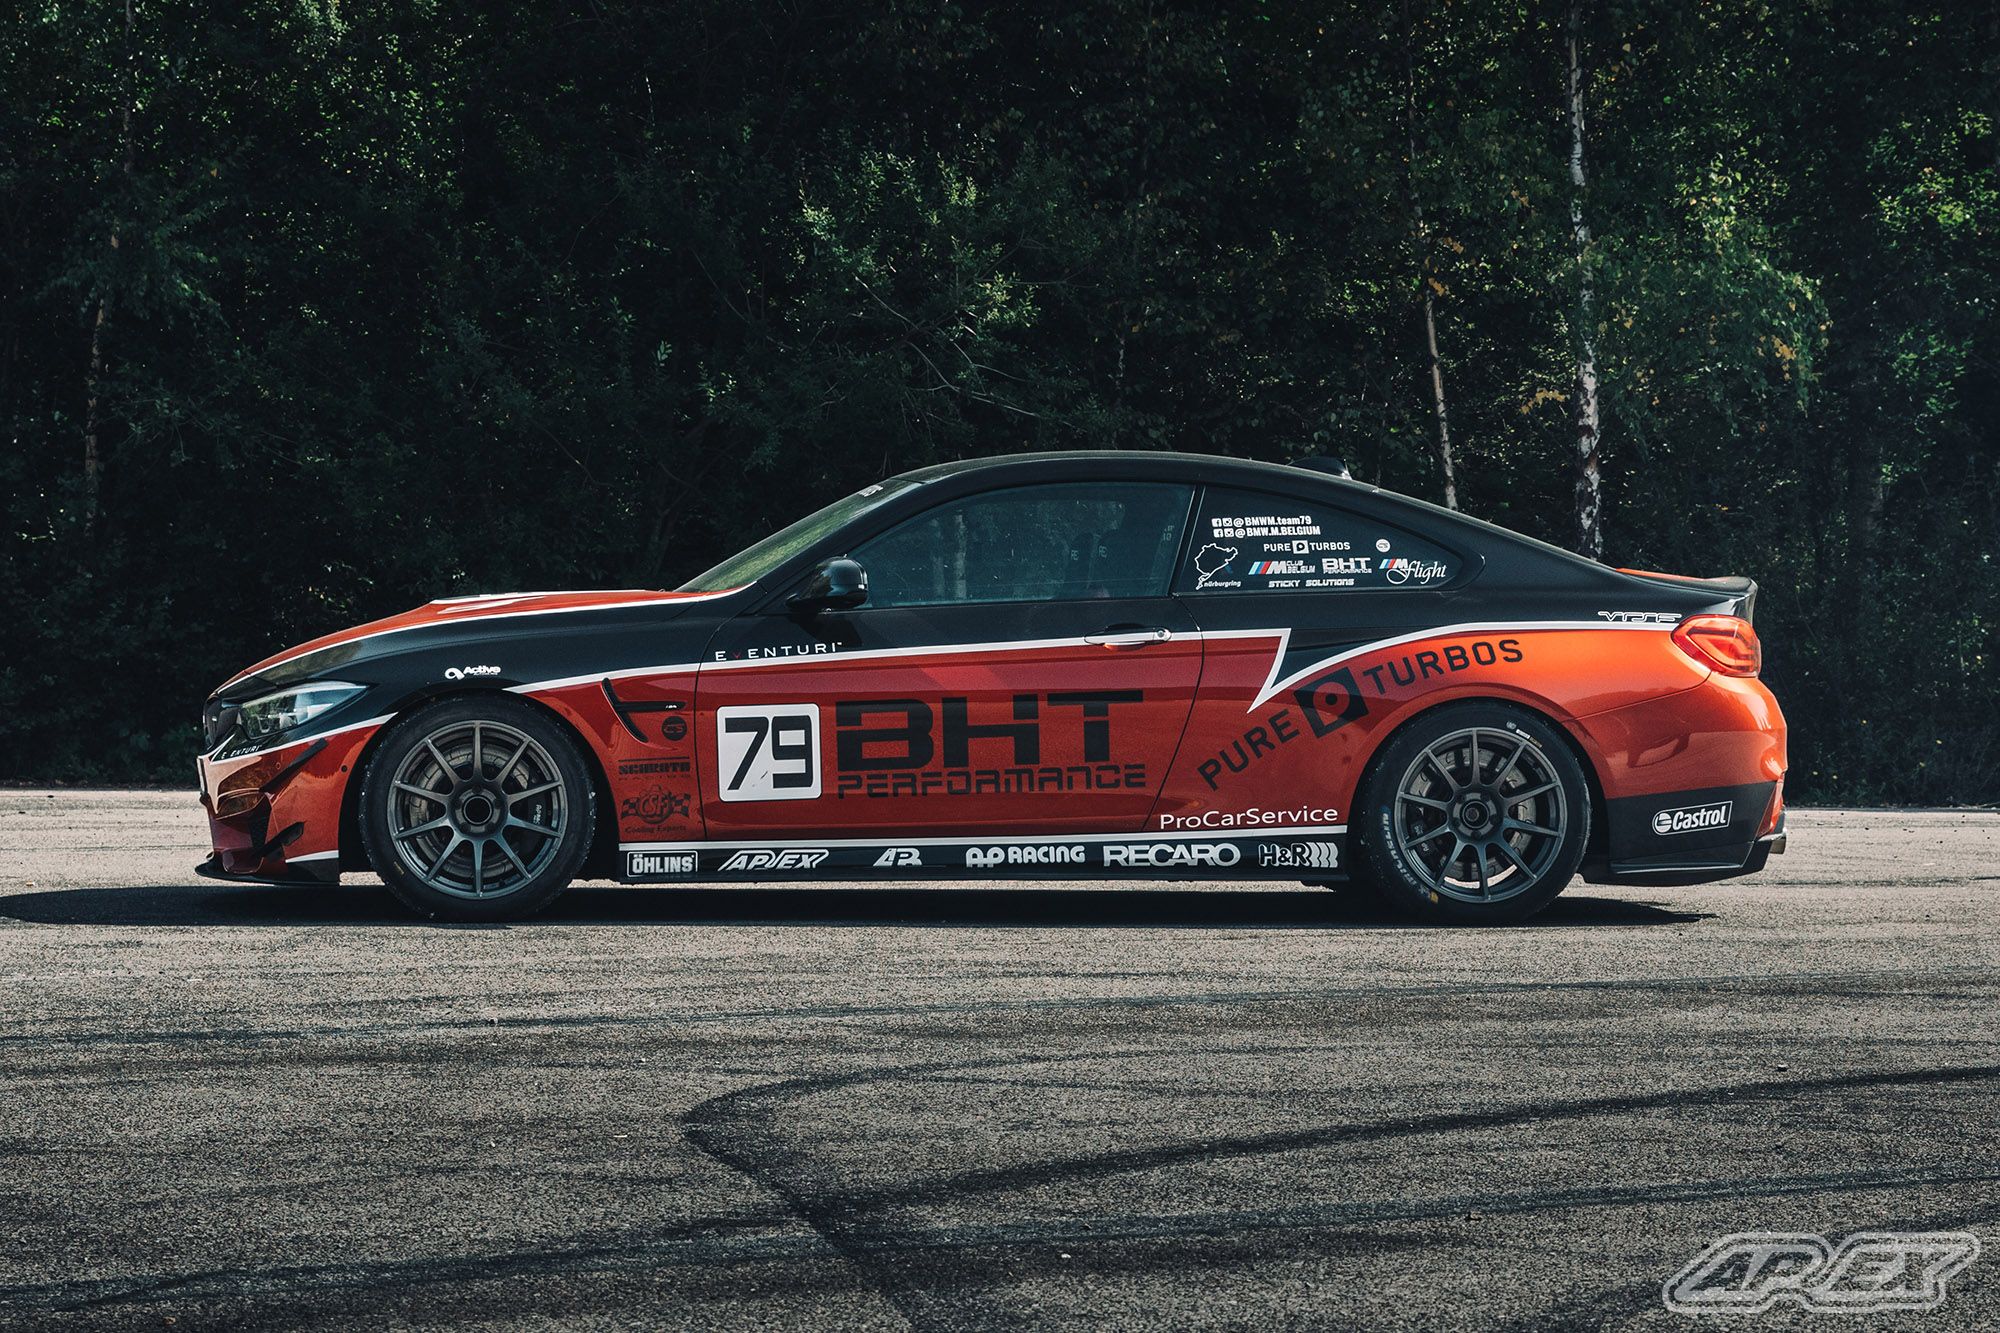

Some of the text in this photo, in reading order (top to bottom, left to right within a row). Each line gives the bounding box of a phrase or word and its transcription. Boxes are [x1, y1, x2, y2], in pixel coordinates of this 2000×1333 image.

[1235, 526, 1321, 538] @BMW.M.BELGIUM
[1263, 541, 1351, 552] PURE TURBOS
[1321, 557, 1371, 570] BHT
[1268, 578, 1355, 588] STICKY SOLUTIONS
[463, 664, 501, 675] Active
[1363, 639, 1523, 694] TURBOS
[836, 690, 1144, 771] BHT
[725, 715, 813, 790] 79
[1197, 709, 1300, 791] PURE
[838, 764, 1147, 799] PERFORMANCE
[1160, 808, 1339, 830] ProCarService
[1672, 805, 1726, 831] Castrol
[632, 854, 693, 874] ÖHLINS
[721, 851, 826, 871] APEX
[965, 845, 1086, 868] AP RACING
[1103, 843, 1241, 867] RECARO
[1258, 843, 1311, 868] H&R
